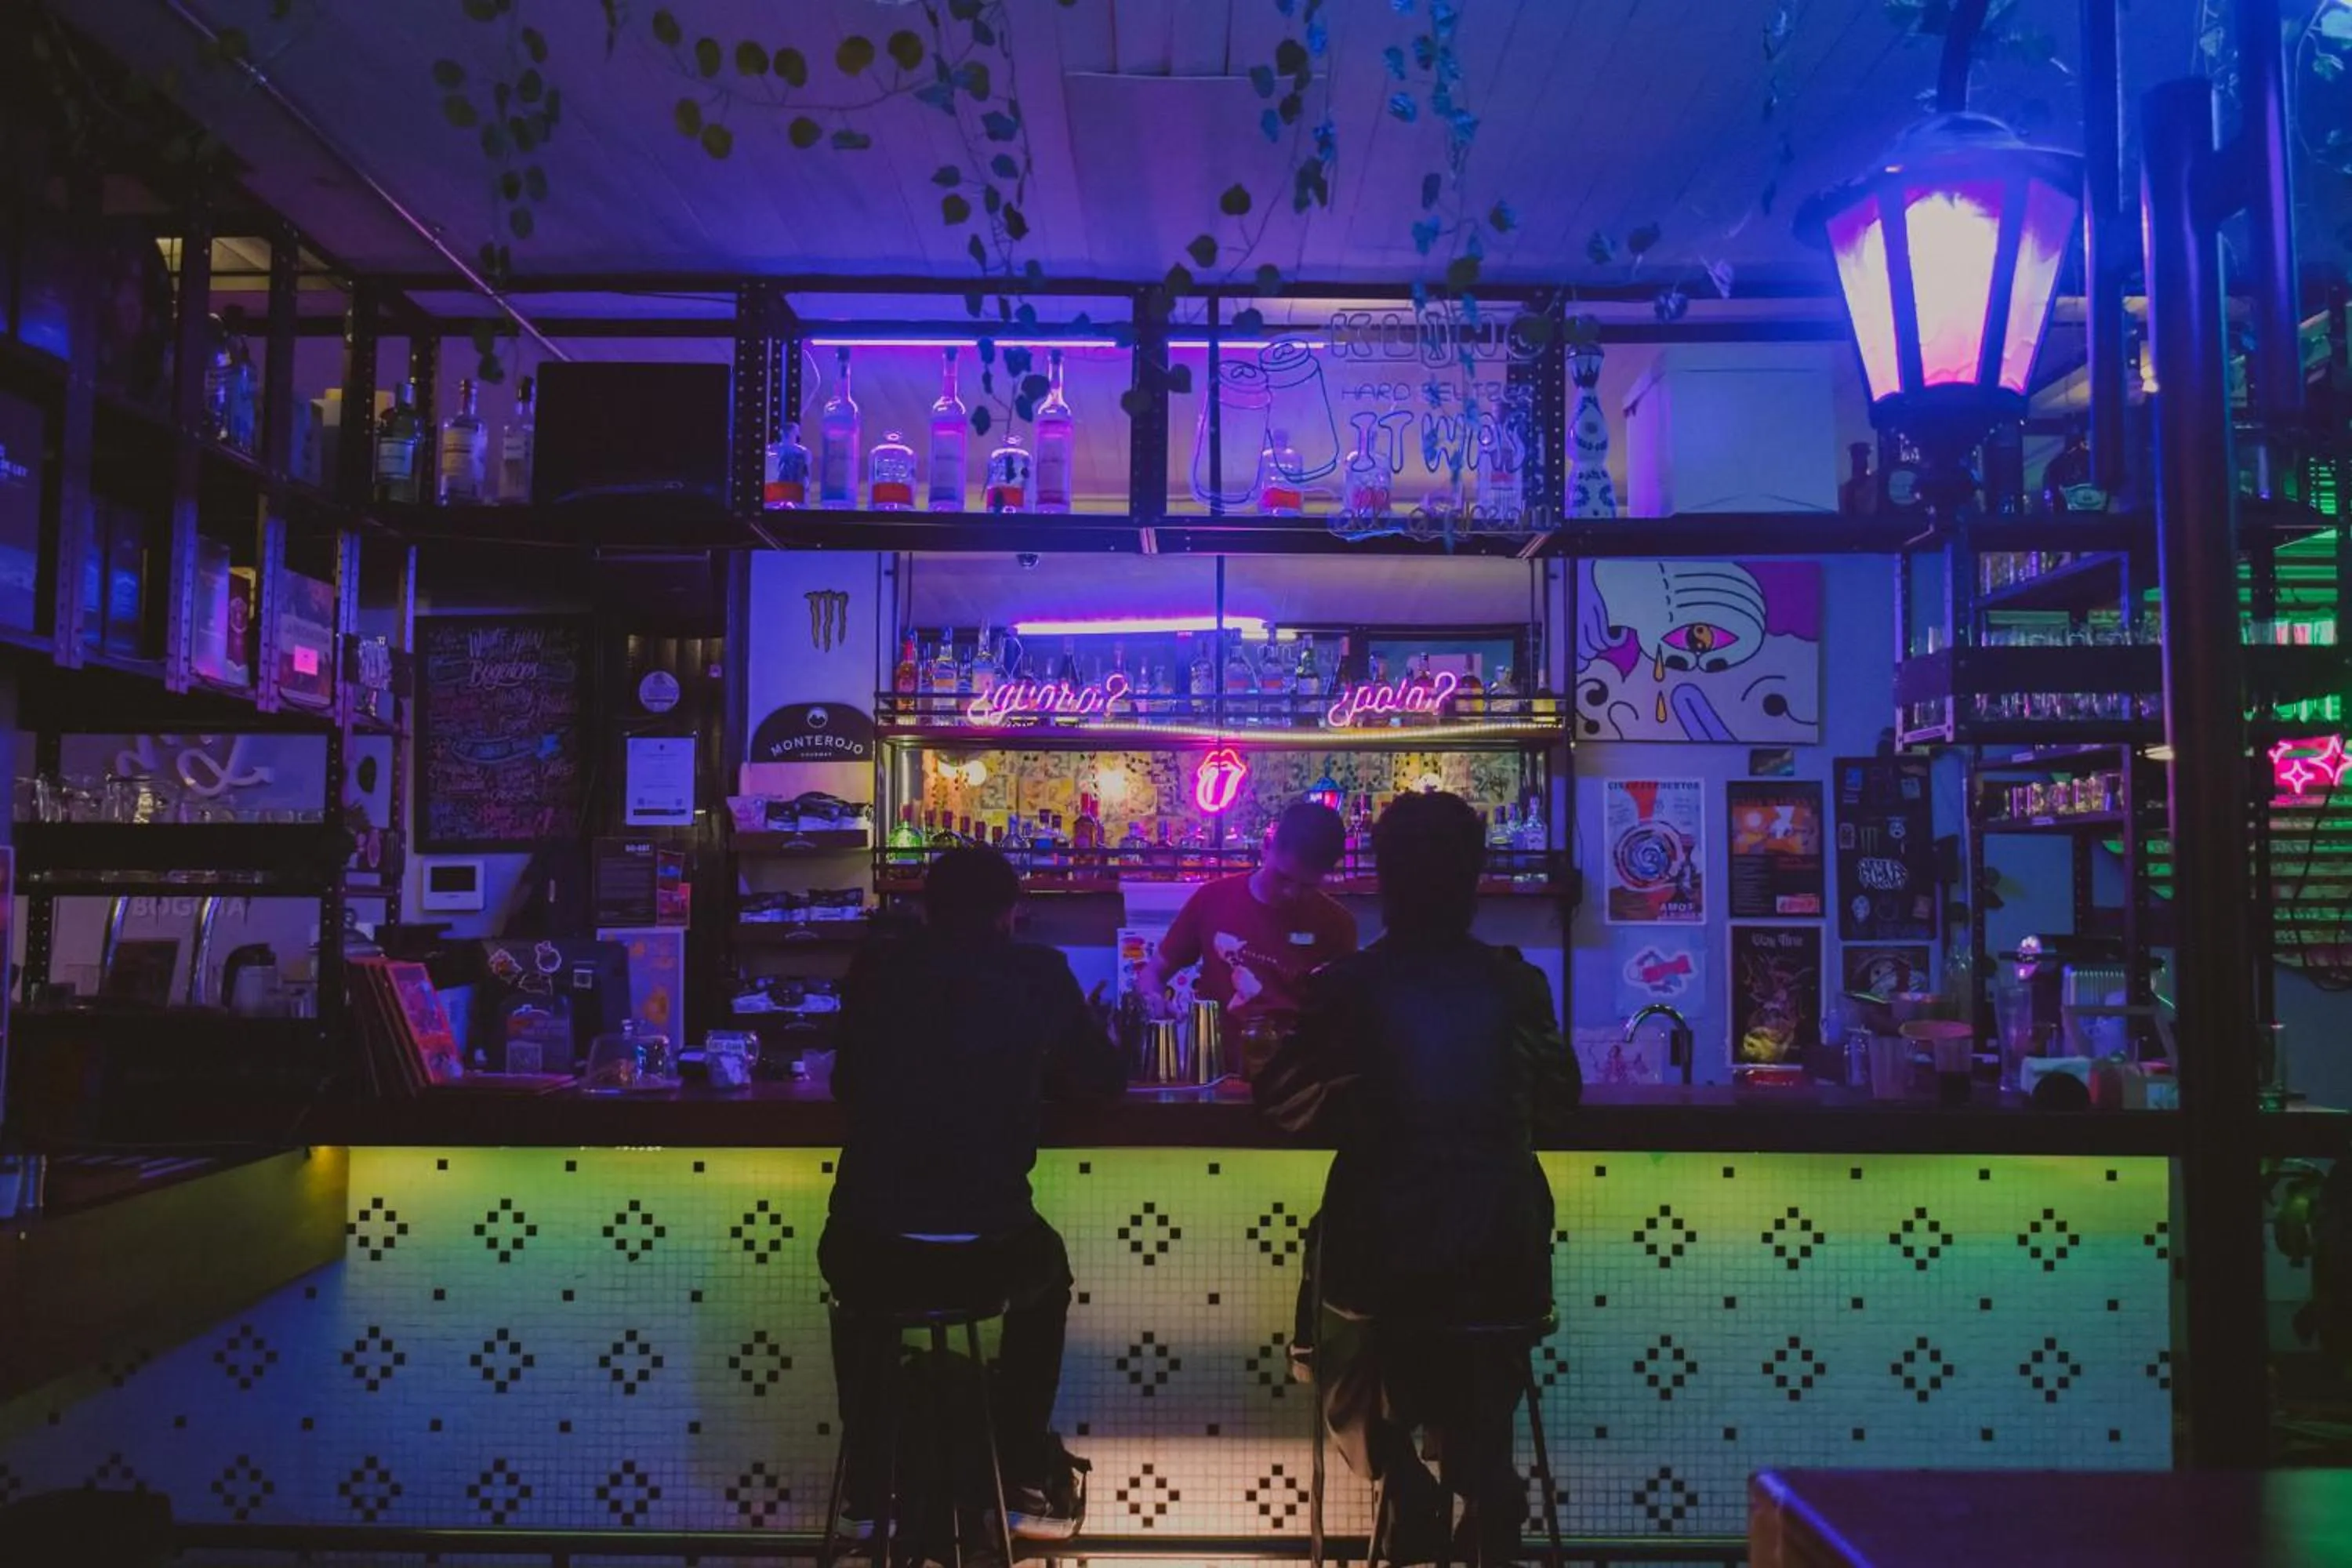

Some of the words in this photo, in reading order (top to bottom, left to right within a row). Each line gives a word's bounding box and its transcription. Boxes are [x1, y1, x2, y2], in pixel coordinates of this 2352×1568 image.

[1342, 382, 1411, 401] HARD
[1350, 410, 1414, 474] IT
[1421, 411, 1527, 474] WAS
[770, 735, 865, 757] MONTEROJO
[132, 895, 245, 916] BOGA
